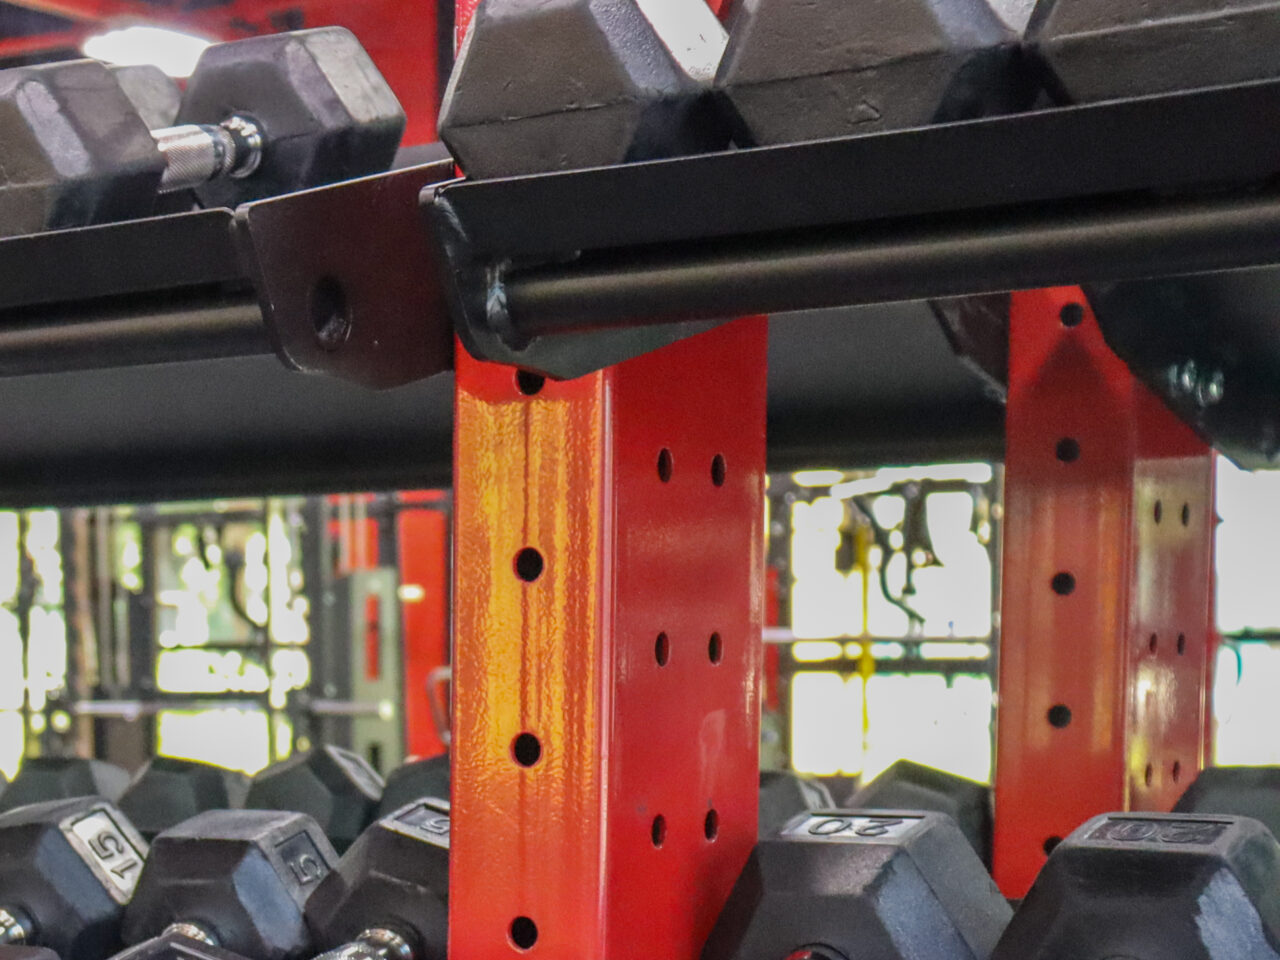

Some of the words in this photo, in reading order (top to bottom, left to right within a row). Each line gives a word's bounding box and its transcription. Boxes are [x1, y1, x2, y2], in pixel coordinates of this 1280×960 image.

[808, 818, 904, 837] 20
[1107, 819, 1215, 844] 20
[86, 829, 139, 881] 15
